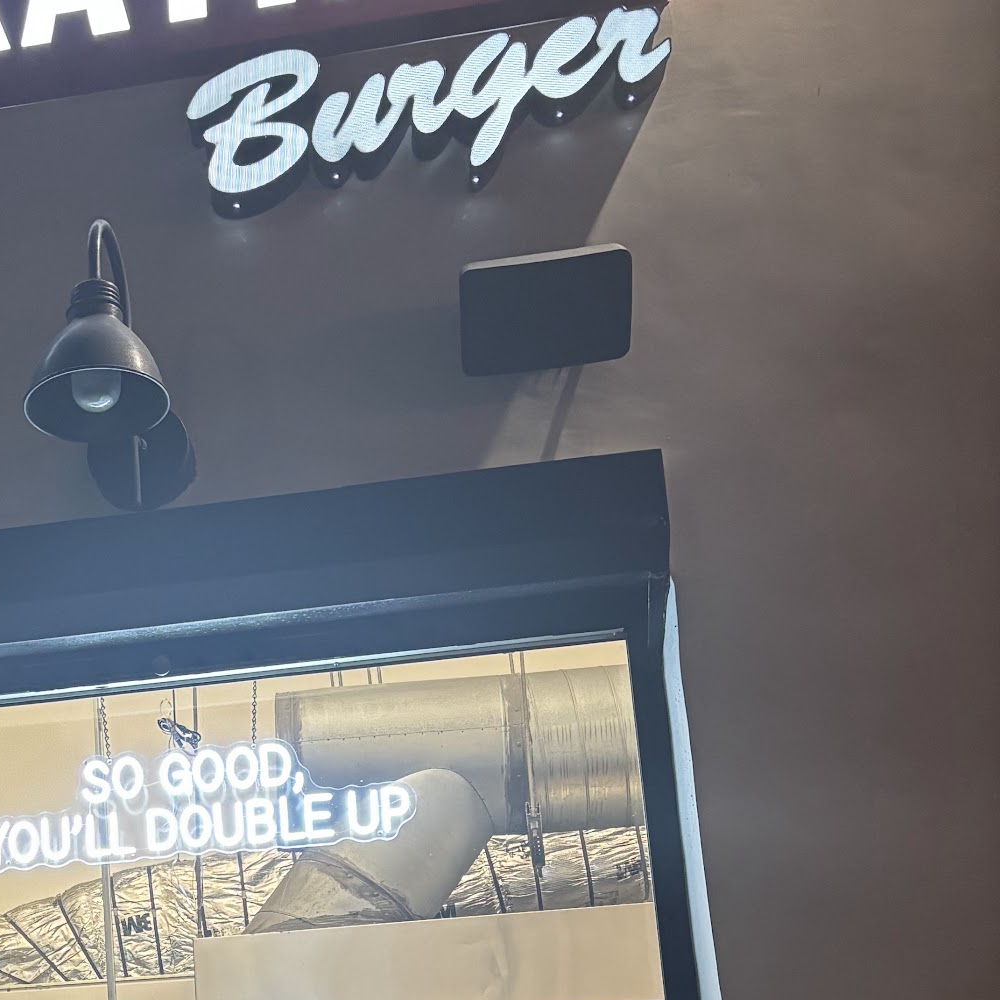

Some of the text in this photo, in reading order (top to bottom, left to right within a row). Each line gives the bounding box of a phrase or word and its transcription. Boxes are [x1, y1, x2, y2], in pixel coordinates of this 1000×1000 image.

[186, 6, 672, 194] Burger
[81, 743, 305, 805] SO GOOD,
[146, 793, 336, 851] DOUBLE
[347, 785, 411, 836] UP
